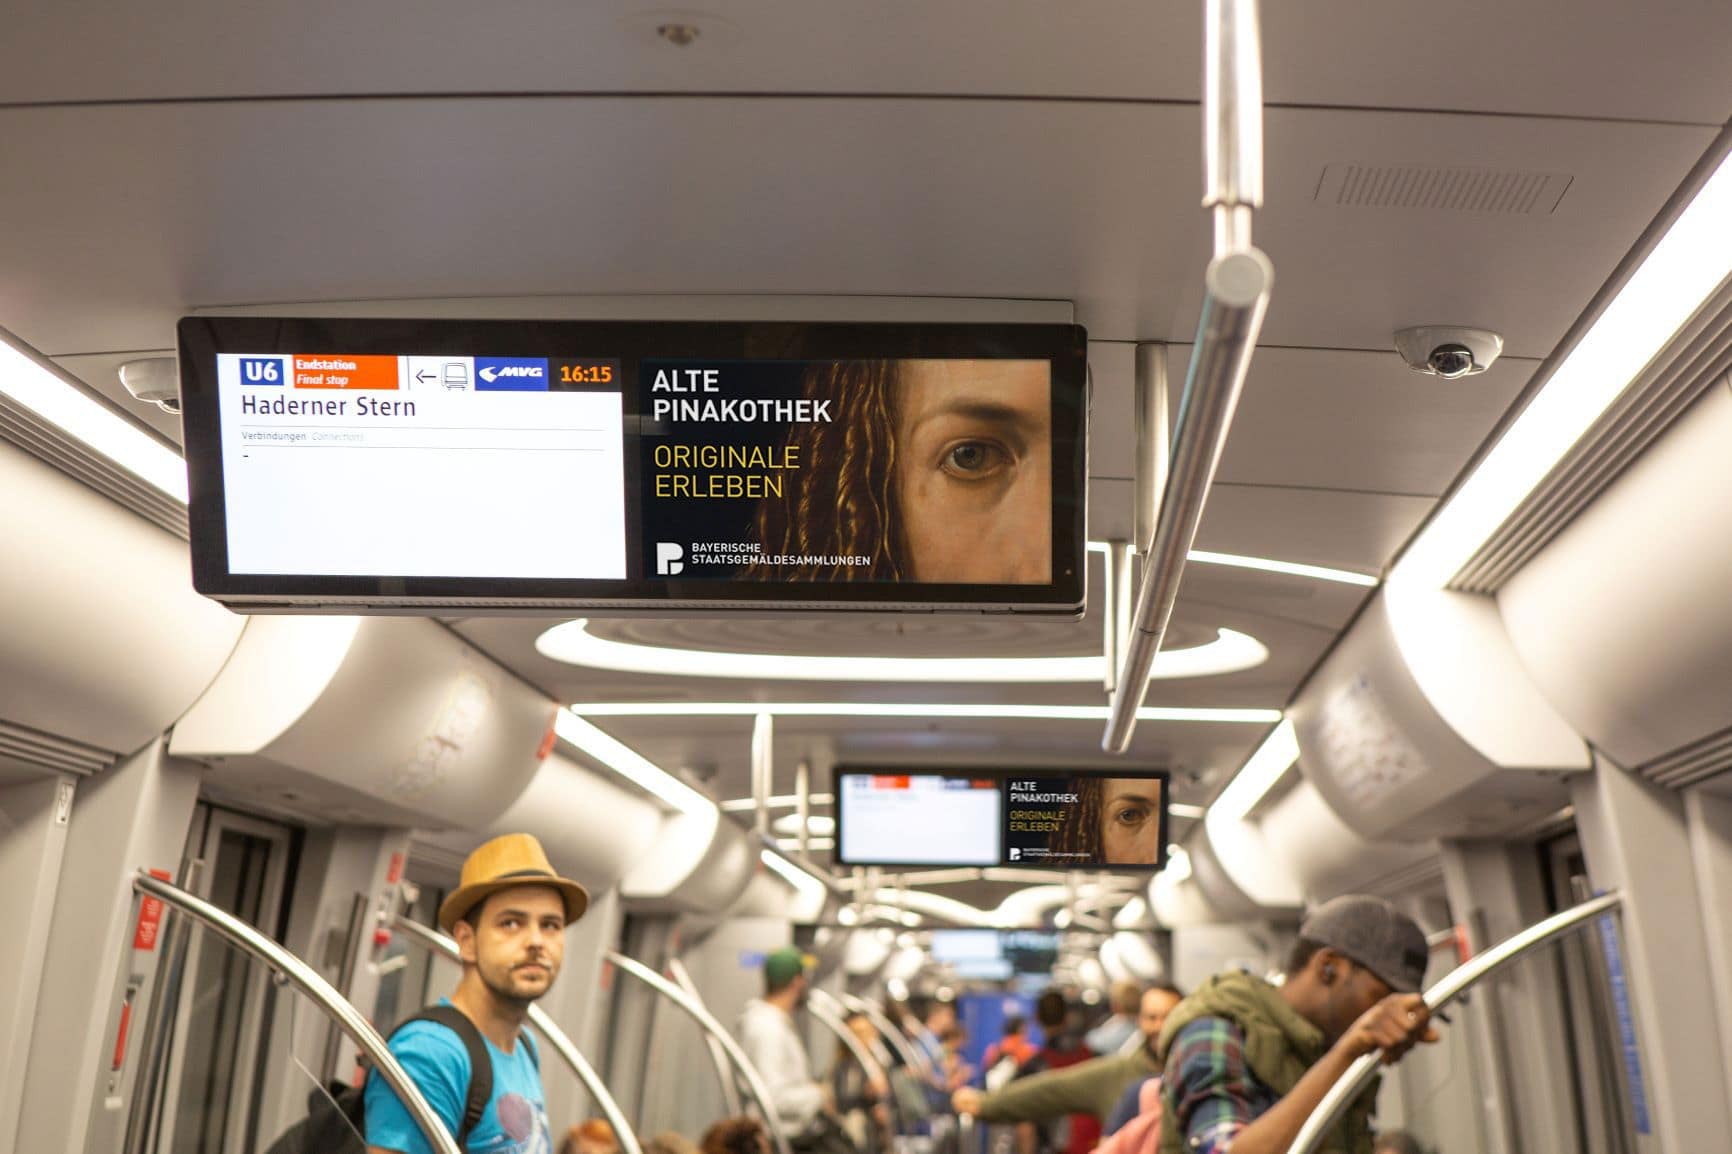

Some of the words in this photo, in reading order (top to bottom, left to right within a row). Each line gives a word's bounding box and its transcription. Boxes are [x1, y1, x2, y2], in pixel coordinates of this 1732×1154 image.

[245, 361, 278, 382] U6
[296, 359, 357, 371] Endstation
[497, 366, 543, 378] MVG
[560, 365, 612, 383] 16:15
[296, 374, 324, 385] Final
[325, 375, 349, 387] stop
[652, 369, 720, 393] ALTE
[242, 394, 347, 416] Haderner
[356, 396, 416, 417] Stern
[653, 399, 832, 423] PINAKOTHEK
[241, 431, 307, 443] Verbindungen
[654, 444, 801, 470] ORIGINALE
[655, 474, 783, 498] ERLEBEN
[691, 542, 761, 553] BAYERISCHE
[691, 552, 871, 567] STAATSGEMÄLDESAMMLUNGEN
[1010, 781, 1038, 792] ALTE
[1010, 793, 1079, 804] PINAKOTHEK
[1009, 810, 1066, 821] ORIGINALE
[1009, 821, 1060, 832] ERLEBEN
